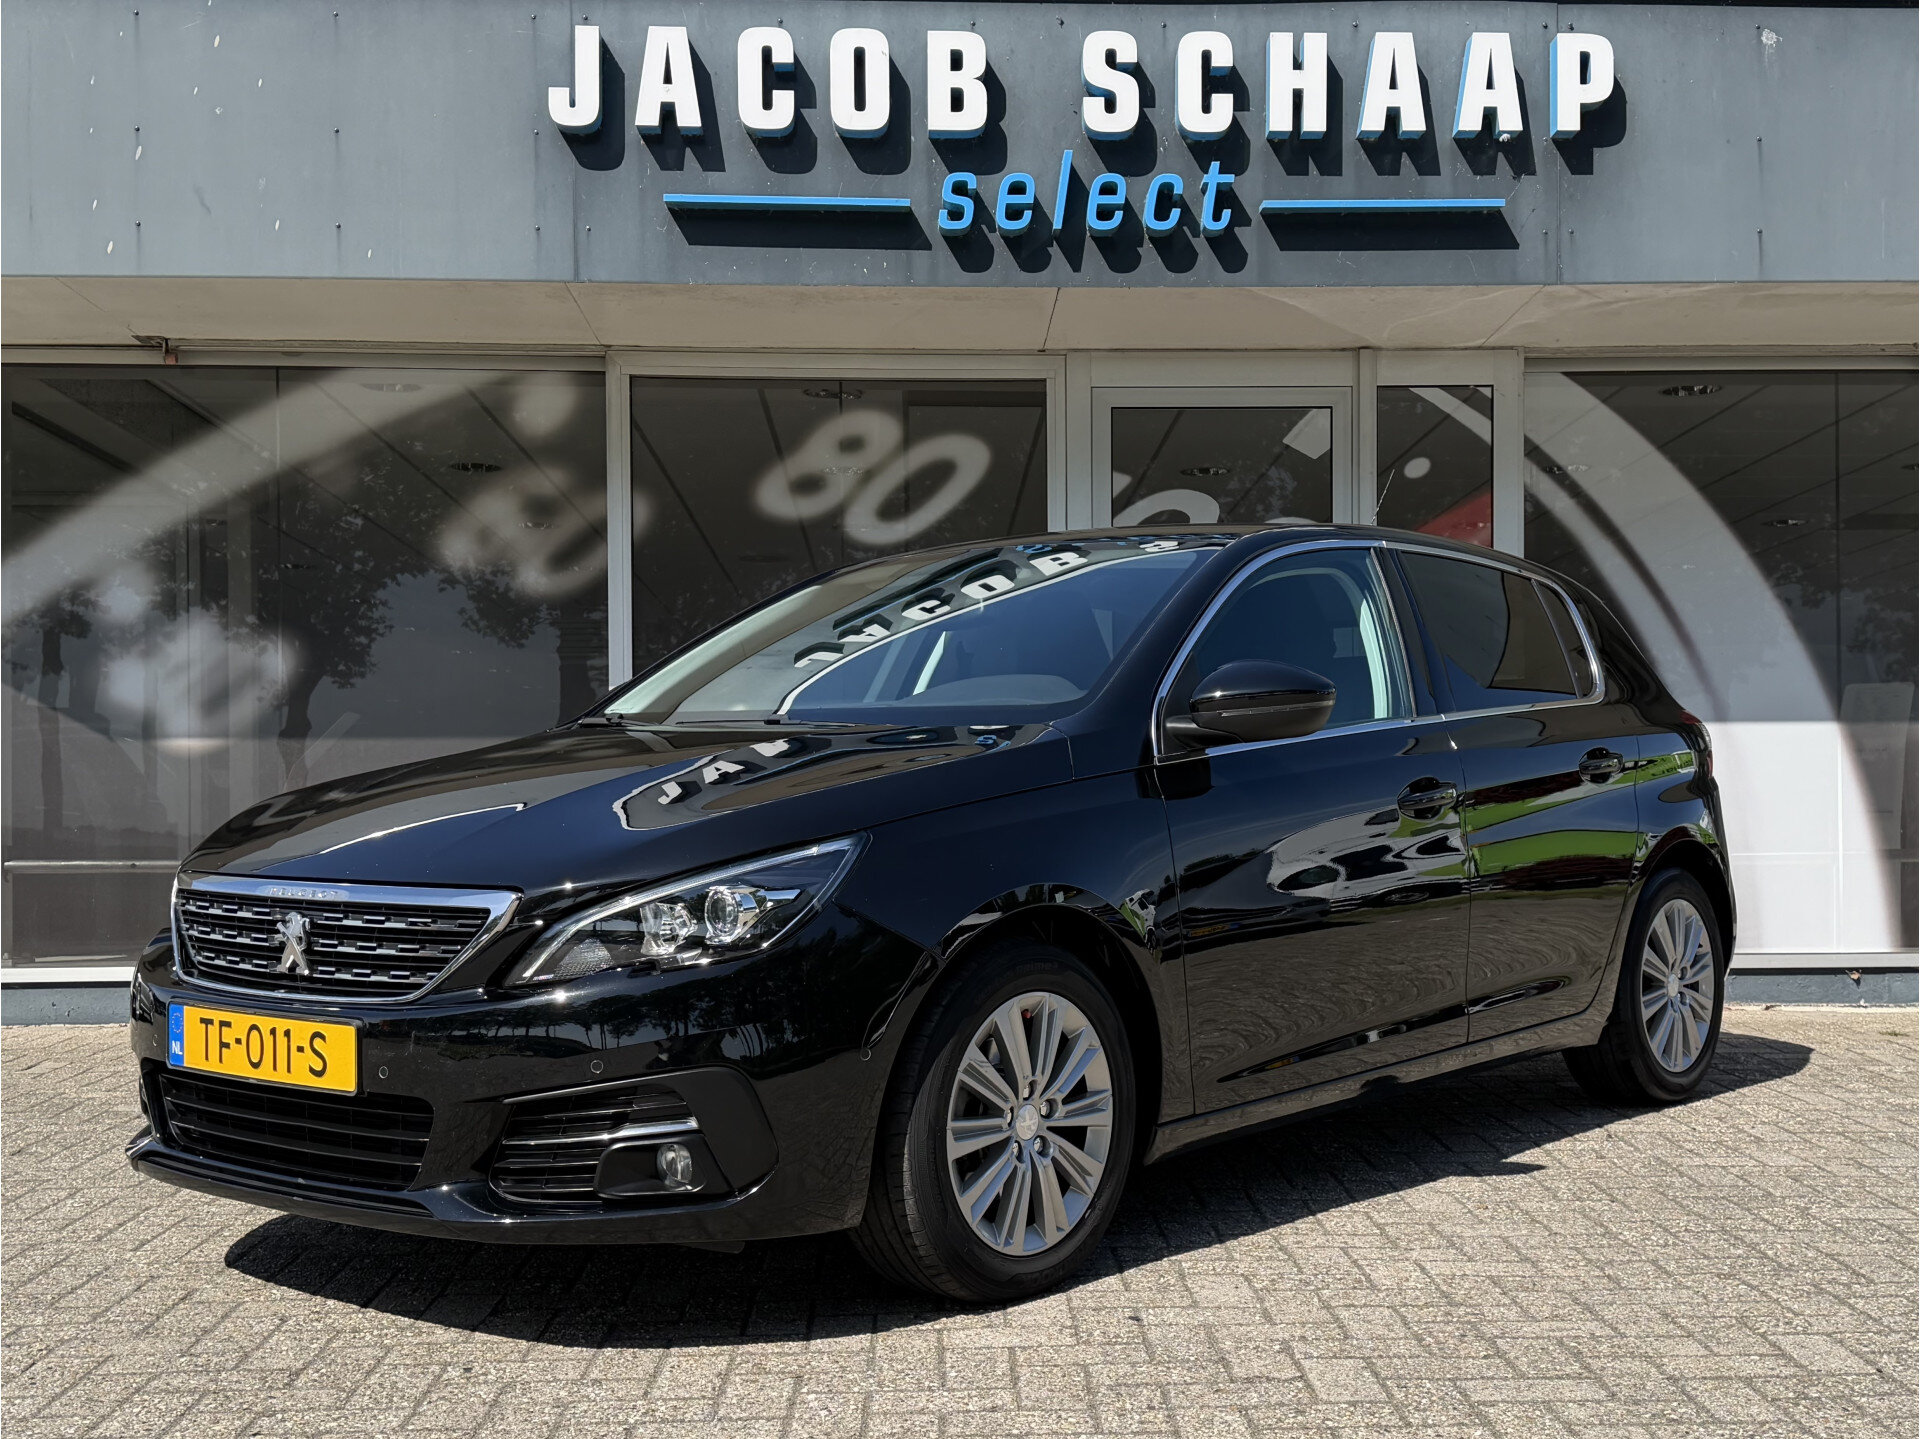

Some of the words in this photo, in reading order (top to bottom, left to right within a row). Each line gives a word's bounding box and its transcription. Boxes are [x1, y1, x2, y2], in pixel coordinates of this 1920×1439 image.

[548, 25, 989, 138] JACOB
[1082, 30, 1615, 140] SCHAAP
[937, 149, 1236, 236] select
[171, 1040, 183, 1056] NL
[199, 1016, 328, 1078] TF-011-S
